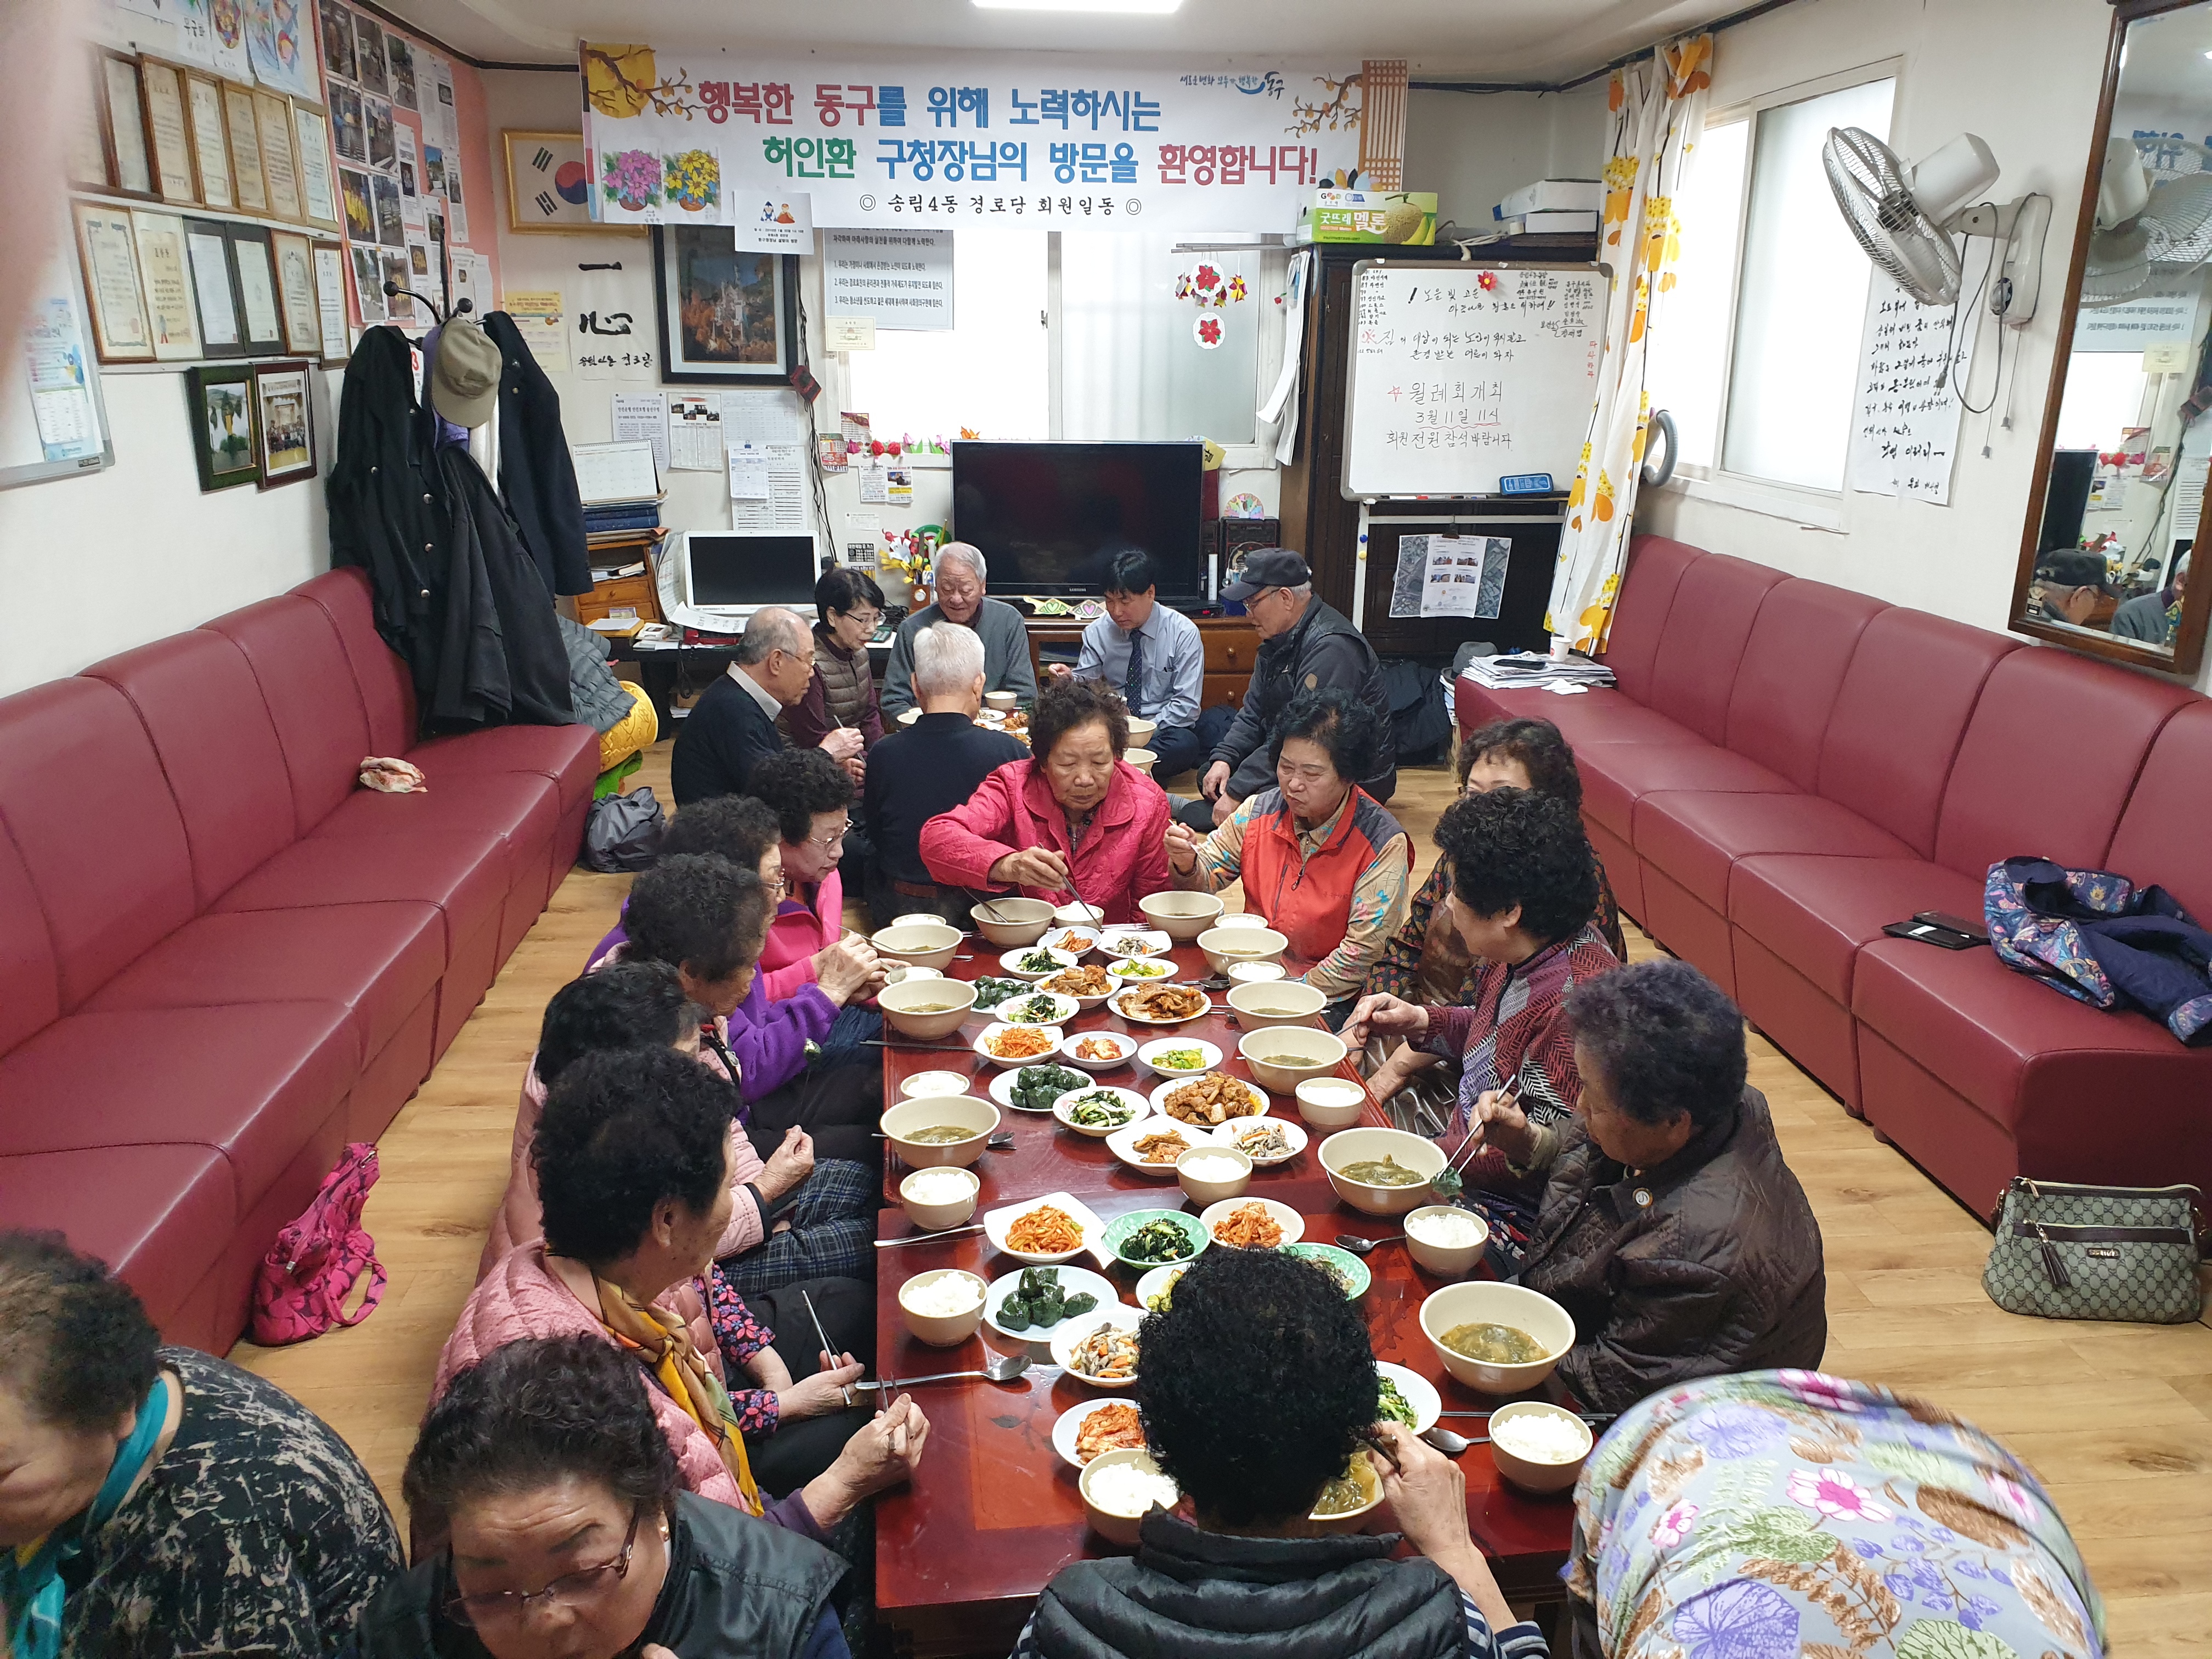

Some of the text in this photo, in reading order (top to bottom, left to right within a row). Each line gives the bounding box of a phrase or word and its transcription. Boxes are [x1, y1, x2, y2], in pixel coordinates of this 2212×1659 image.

[1264, 71, 1285, 100] 동구
[698, 80, 1161, 132] 행복한 동구를 위해 노력하시는
[763, 136, 1318, 186] 허인환 구청장님의 방문을 환영합니다!
[887, 194, 958, 215] 송림4동
[969, 194, 1026, 216] 경로당
[1320, 211, 1390, 234] 굿뜨래 멜론
[1415, 409, 1438, 425] 3월
[1386, 430, 1408, 450] 회원
[1411, 431, 1440, 449] 전원
